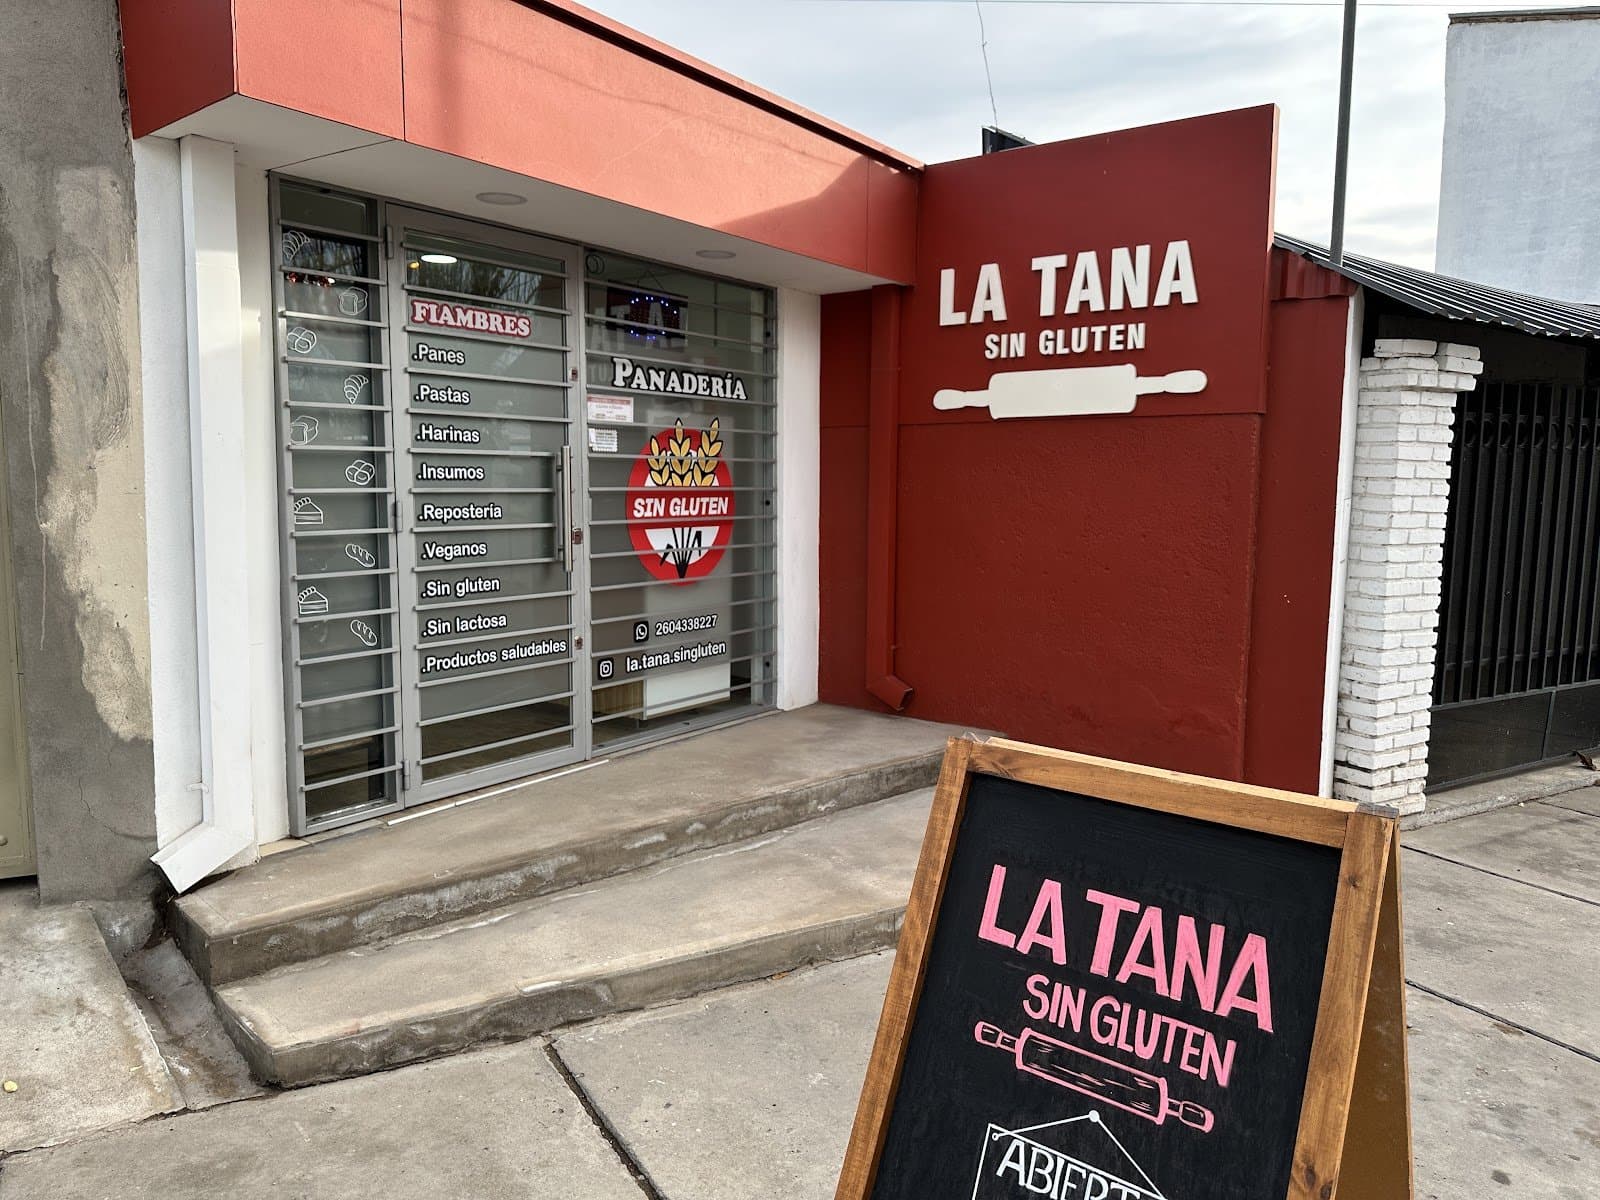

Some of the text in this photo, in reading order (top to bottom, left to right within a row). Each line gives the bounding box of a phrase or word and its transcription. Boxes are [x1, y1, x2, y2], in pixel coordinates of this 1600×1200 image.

[939, 239, 1199, 327] LA TANA
[411, 300, 531, 337] FIAMBRES
[984, 322, 1146, 360] SIN GLUTEN
[412, 344, 465, 365] .Panes
[415, 385, 470, 404] .Pastas
[415, 423, 480, 444] .Harinas
[416, 463, 485, 481] .Insumos
[418, 502, 502, 522] .Repostería
[633, 497, 728, 518] SIN GLUTEN
[421, 541, 487, 561] .Veganos
[421, 577, 500, 599] .Sin gluten
[421, 613, 507, 638] .Sin lactosa
[655, 614, 717, 636] 2604338227
[421, 639, 567, 675] .Productos saludables
[626, 640, 726, 674] la.tana.singluten
[978, 864, 1273, 1033] LA TANA
[1023, 973, 1236, 1088] SIN GLUTEN
